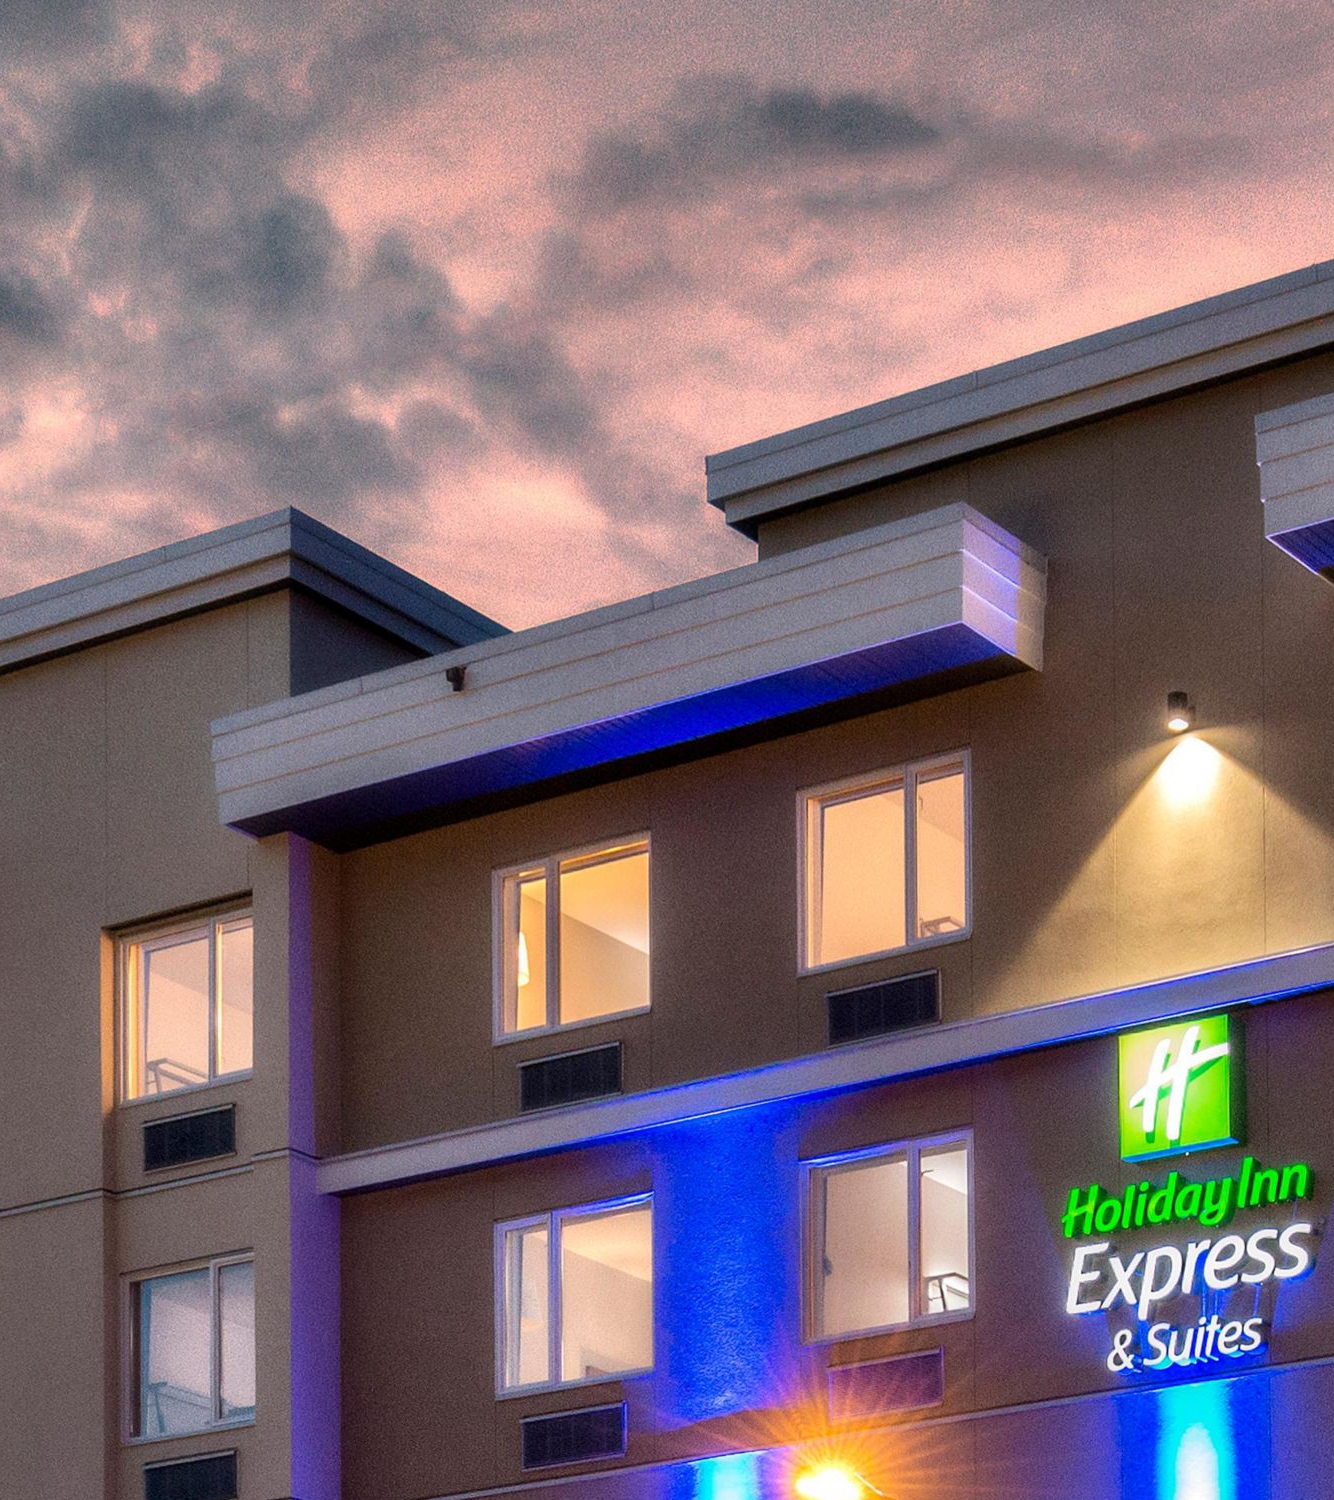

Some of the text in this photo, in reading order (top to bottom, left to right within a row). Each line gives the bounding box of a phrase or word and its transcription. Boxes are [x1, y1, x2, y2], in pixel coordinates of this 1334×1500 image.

[1062, 1156, 1308, 1238] Holiday Inn
[1066, 1223, 1312, 1321] Express
[1107, 1314, 1263, 1372] & Suites
